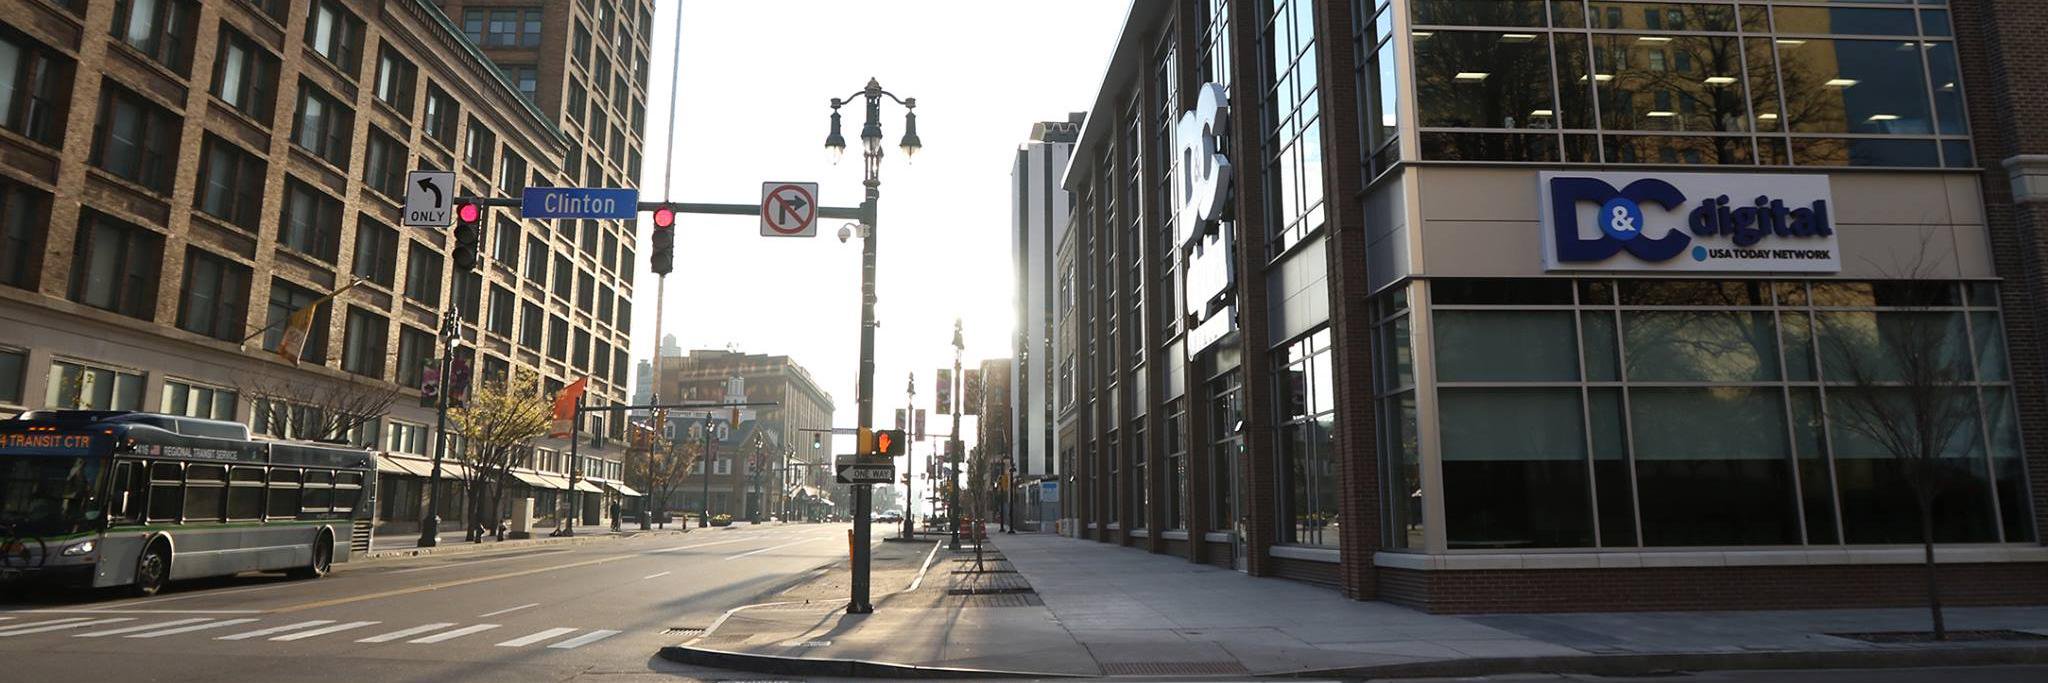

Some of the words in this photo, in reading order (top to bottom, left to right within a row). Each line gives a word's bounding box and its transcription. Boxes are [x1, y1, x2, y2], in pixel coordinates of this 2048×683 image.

[544, 192, 615, 214] Clinton
[410, 210, 446, 223] ONLY
[1550, 176, 1692, 263] D&C
[1689, 194, 1832, 247] digital
[1709, 248, 1732, 259] USA
[1732, 249, 1770, 259] TODAY
[1773, 249, 1831, 260] NETWORK
[9, 434, 62, 448] TRANSIT
[64, 435, 89, 449] CTR
[163, 445, 192, 458] REGIONAL
[193, 447, 215, 459] TRANSIT
[216, 449, 238, 460] SERVICE
[855, 470, 871, 479] ONE
[872, 470, 889, 479] WAY
